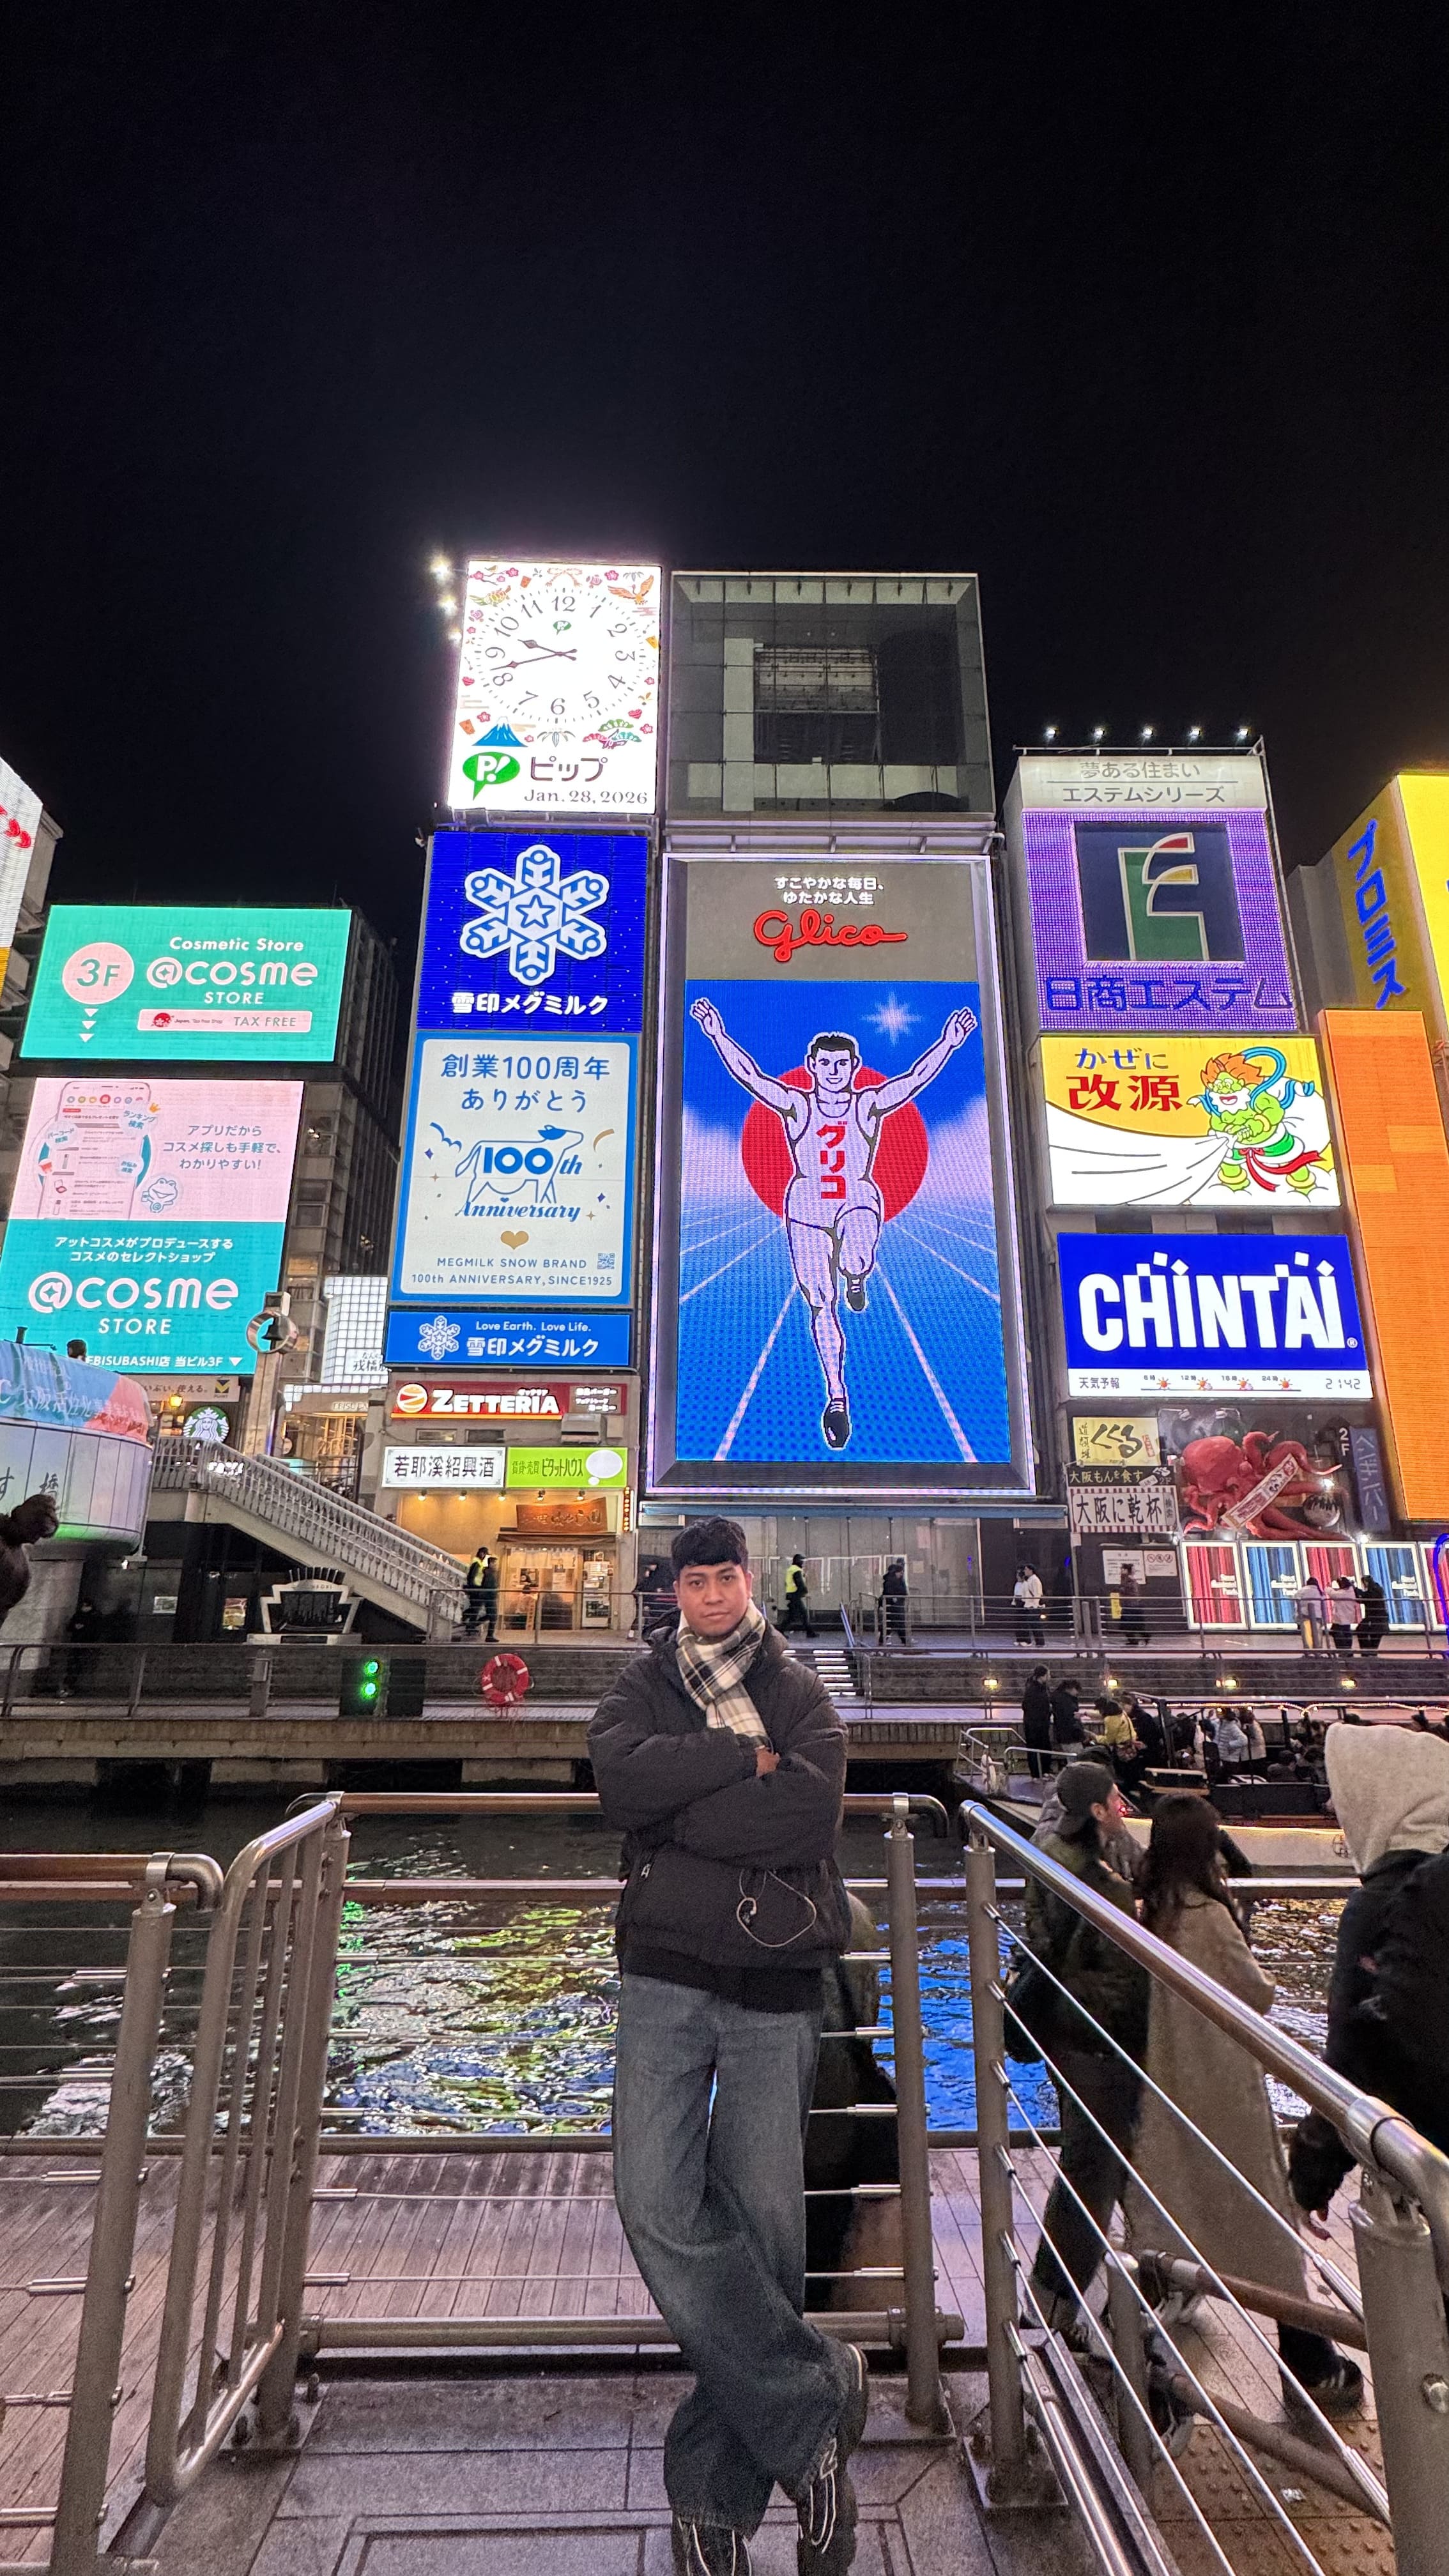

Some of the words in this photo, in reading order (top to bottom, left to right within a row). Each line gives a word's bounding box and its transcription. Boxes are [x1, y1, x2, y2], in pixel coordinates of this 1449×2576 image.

[521, 599, 543, 618] 11
[551, 595, 576, 612] 12
[589, 604, 602, 618] 1
[493, 617, 519, 638] 10
[607, 623, 627, 638] 2
[485, 647, 505, 659] 9
[615, 650, 635, 661] 3
[493, 673, 513, 686] 8
[608, 675, 625, 689] 4
[519, 691, 539, 706] 7
[550, 698, 565, 715] 6
[583, 691, 600, 709] 5
[530, 755, 608, 782] ピップ
[1080, 762, 1200, 779] 夢ある住まい
[524, 789, 565, 802] Jan.
[601, 791, 648, 804] 2026
[1062, 786, 1225, 803] エステムシリーズ
[774, 877, 885, 891] すこやかな毎日、
[783, 891, 874, 905] ゆたかな人生
[1347, 818, 1406, 1010] プロミス
[753, 908, 908, 962] Glico
[169, 937, 250, 951] Cosmetic
[256, 938, 304, 952] Store
[76, 958, 121, 987] 3F
[146, 956, 318, 989] @cosme
[203, 992, 265, 1004] STORE
[1045, 975, 1294, 1012] 日商エステム
[451, 991, 608, 1015] 雪印メグミルク
[234, 1016, 260, 1026] TAX
[264, 1017, 297, 1027] FREE
[441, 1053, 611, 1080] 創業100周年
[1075, 1046, 1169, 1071] かぜに
[461, 1088, 587, 1113] ありがとう
[1066, 1073, 1183, 1112] 改源
[187, 1124, 262, 1136] アプリだから
[163, 1141, 281, 1153] コスメ探しも手軽で、
[816, 1120, 848, 1200] グリコ
[454, 1201, 581, 1222] Anniversary
[56, 1236, 234, 1250] アットコスメがプロデュースする
[70, 1251, 216, 1263] コスメのセレクトショップ
[437, 1257, 494, 1268] MEGMILK
[500, 1258, 537, 1268] SNOW
[543, 1259, 587, 1269] BRAND
[411, 1274, 444, 1284] 100th
[28, 1271, 239, 1314] @cosme
[1078, 1252, 1346, 1353] CHINTAI
[98, 1317, 172, 1335] STORE
[476, 1321, 500, 1331] Love
[503, 1321, 537, 1331] Earth.
[541, 1322, 565, 1331] Love
[568, 1322, 592, 1332] Life.
[466, 1334, 599, 1357] 雪印メグミルク
[1078, 1376, 1120, 1389] 天気予報
[431, 1389, 560, 1414] ZETTERIA
[1091, 1423, 1143, 1459] くくる
[1338, 1427, 1350, 1457] 2F
[542, 1457, 583, 1476] ピタットハウス
[1070, 1469, 1144, 1484] 大阪もんを食す
[1076, 1493, 1163, 1525] 大阪に乾杯
